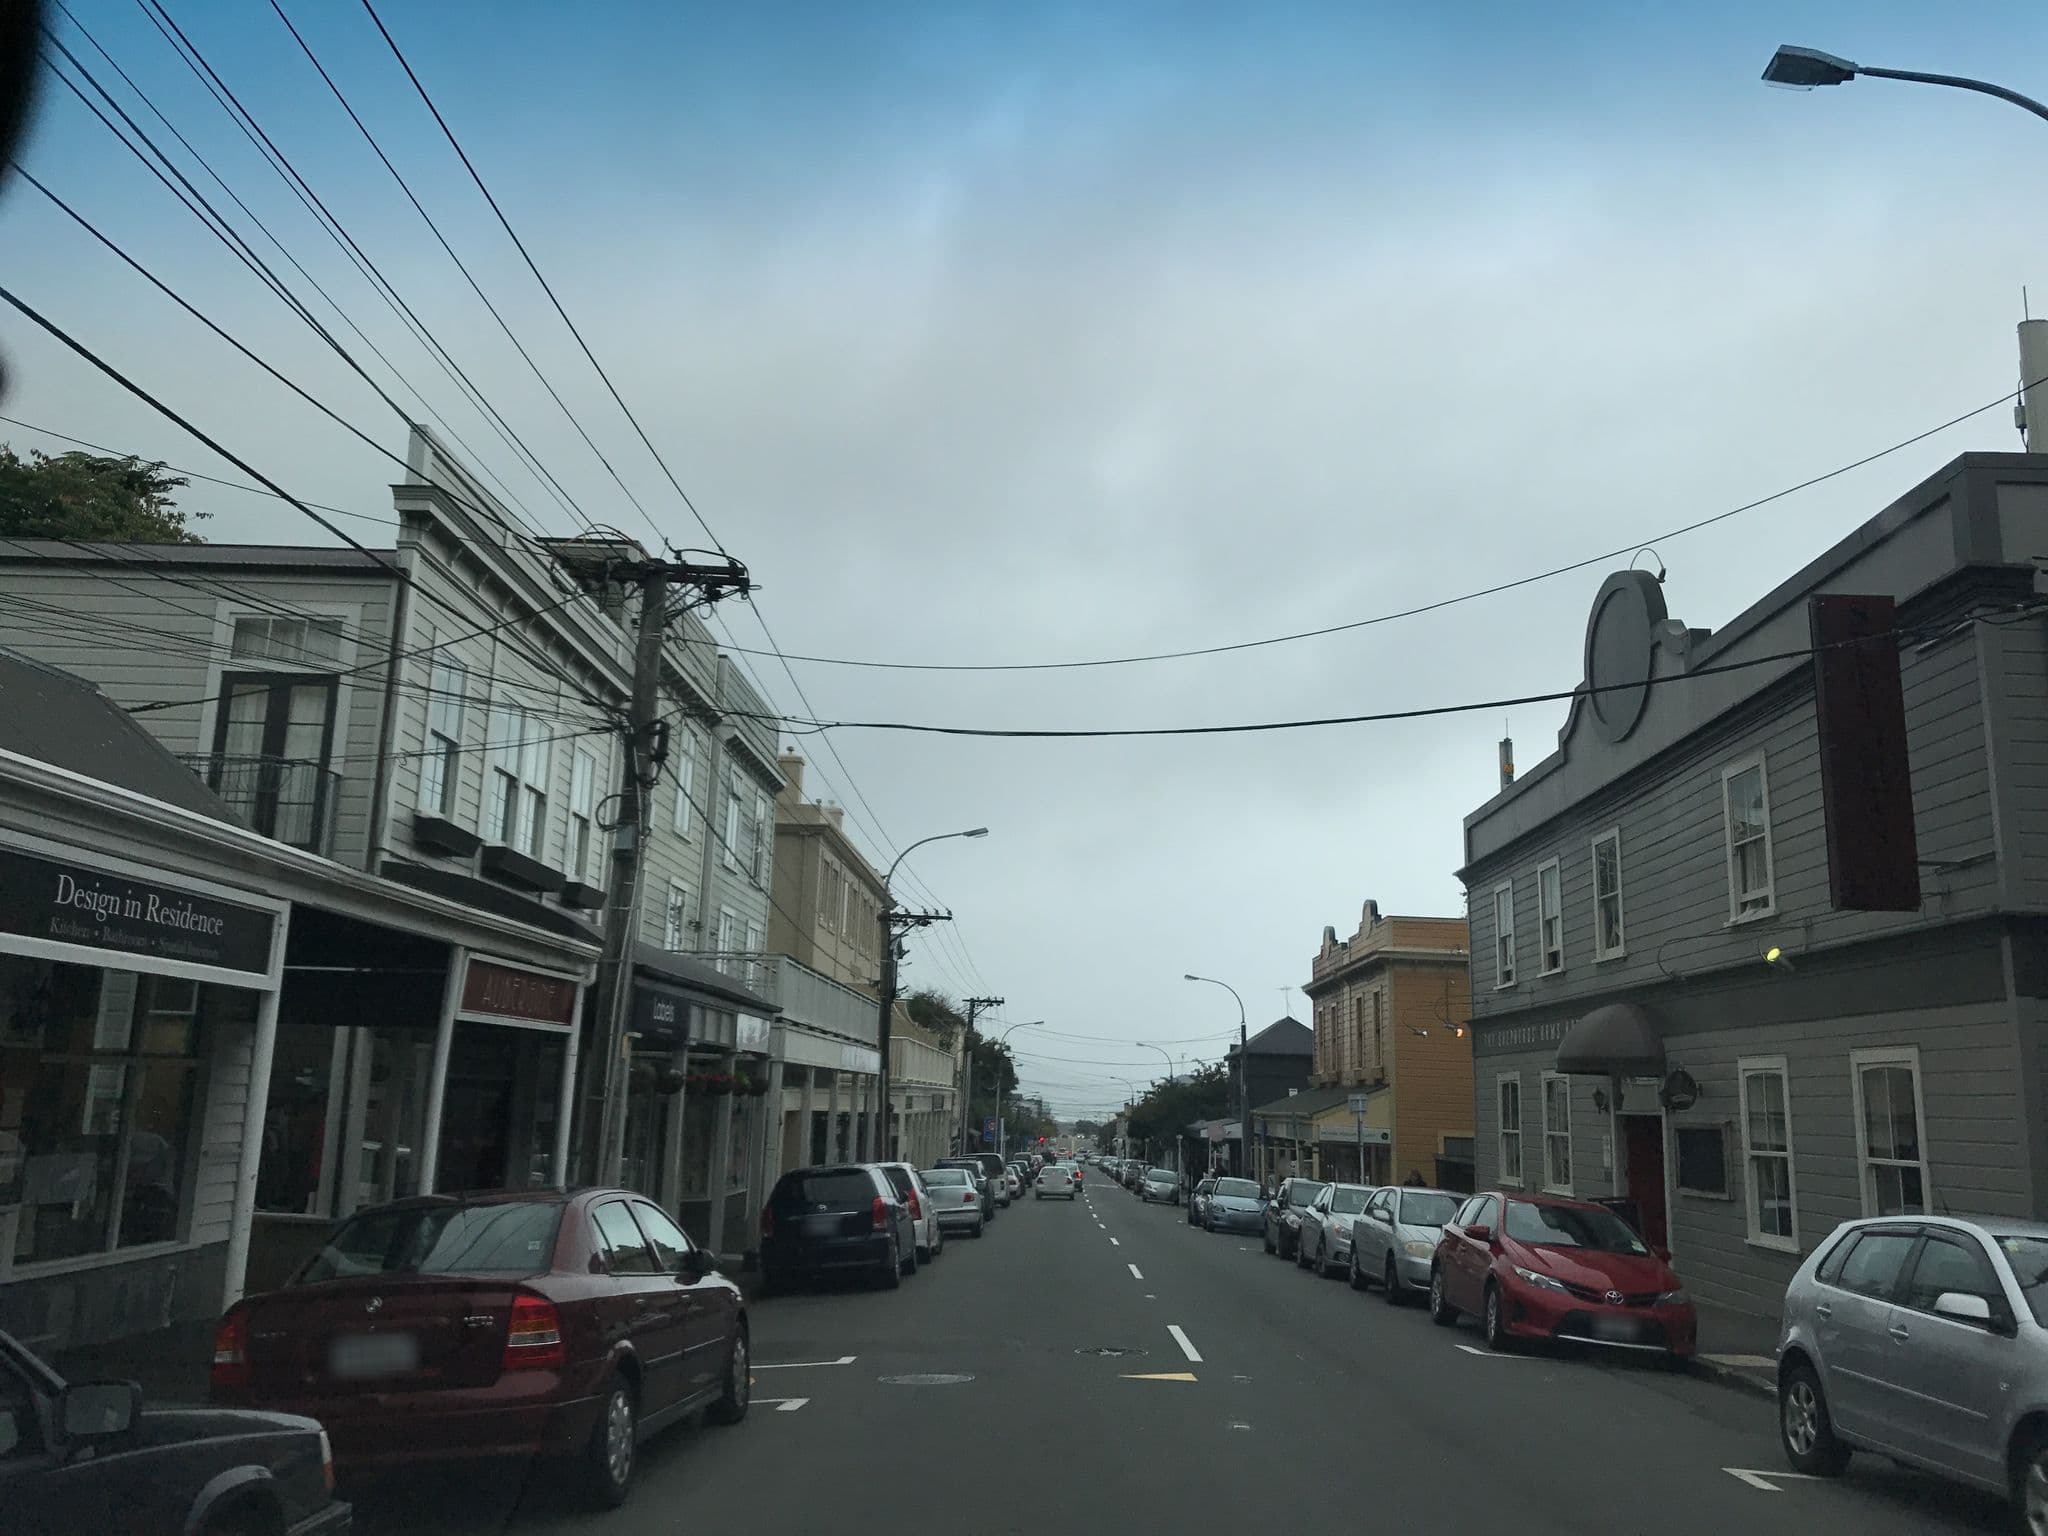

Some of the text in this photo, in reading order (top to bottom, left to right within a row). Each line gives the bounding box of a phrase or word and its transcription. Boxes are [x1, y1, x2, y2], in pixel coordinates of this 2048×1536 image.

[54, 874, 223, 935] Design in Residence
